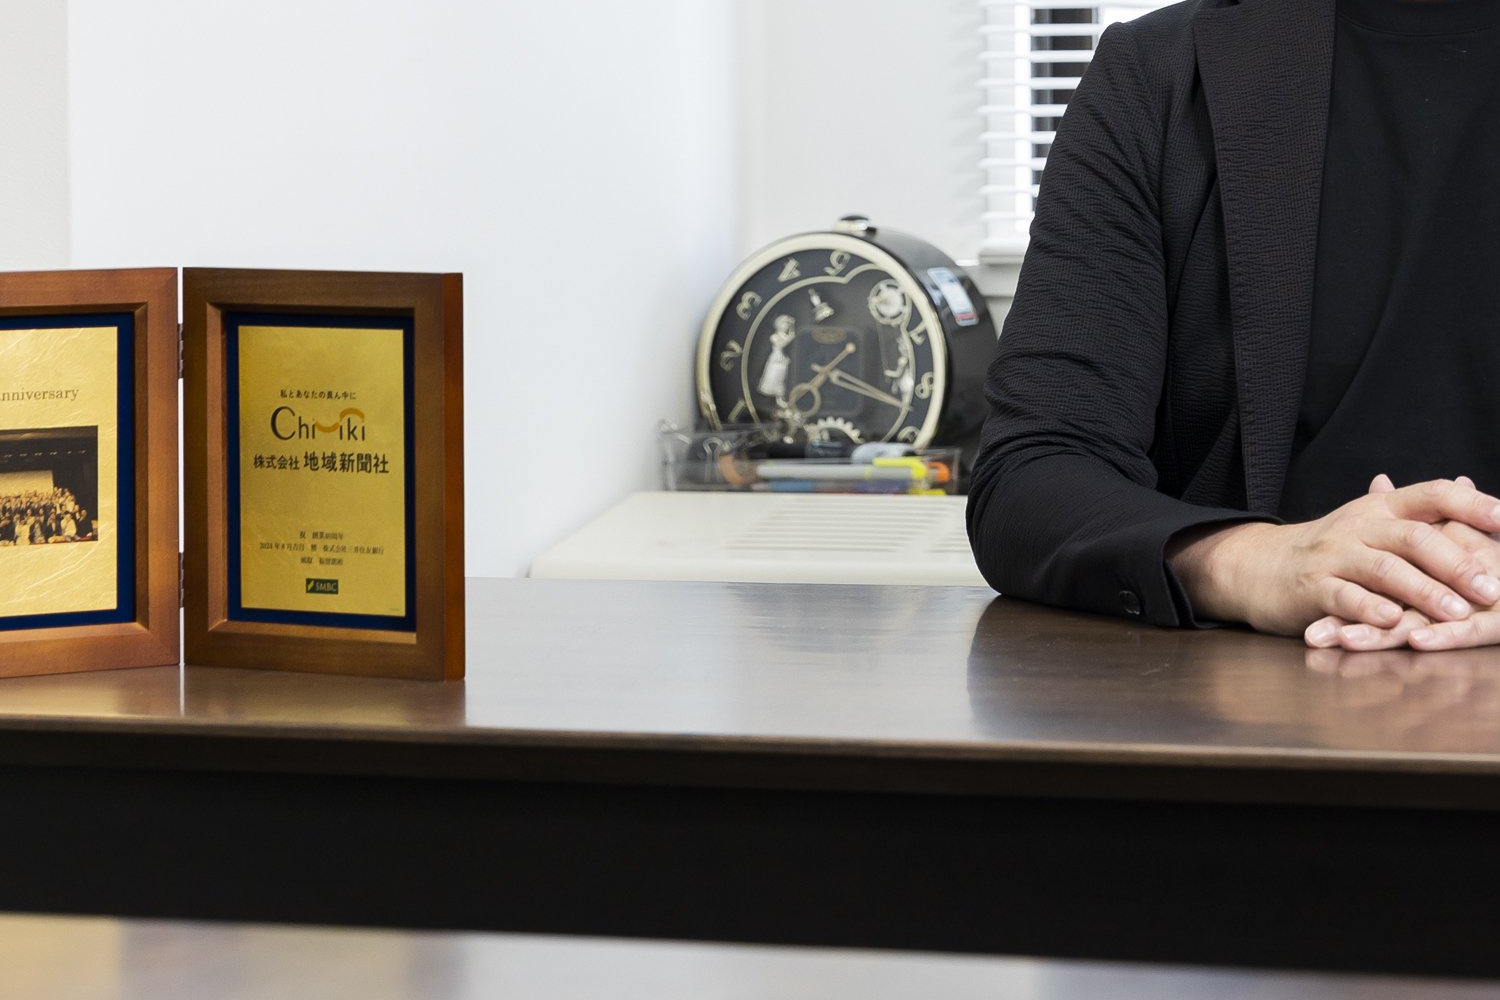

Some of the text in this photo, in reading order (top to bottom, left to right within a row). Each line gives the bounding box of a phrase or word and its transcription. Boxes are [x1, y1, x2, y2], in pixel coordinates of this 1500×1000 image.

[735, 291, 761, 320] 3
[0, 387, 79, 402] nniversary
[915, 371, 934, 400] 8
[253, 451, 389, 474] 株式会社 地域新聞社
[315, 582, 337, 592] SMBC
